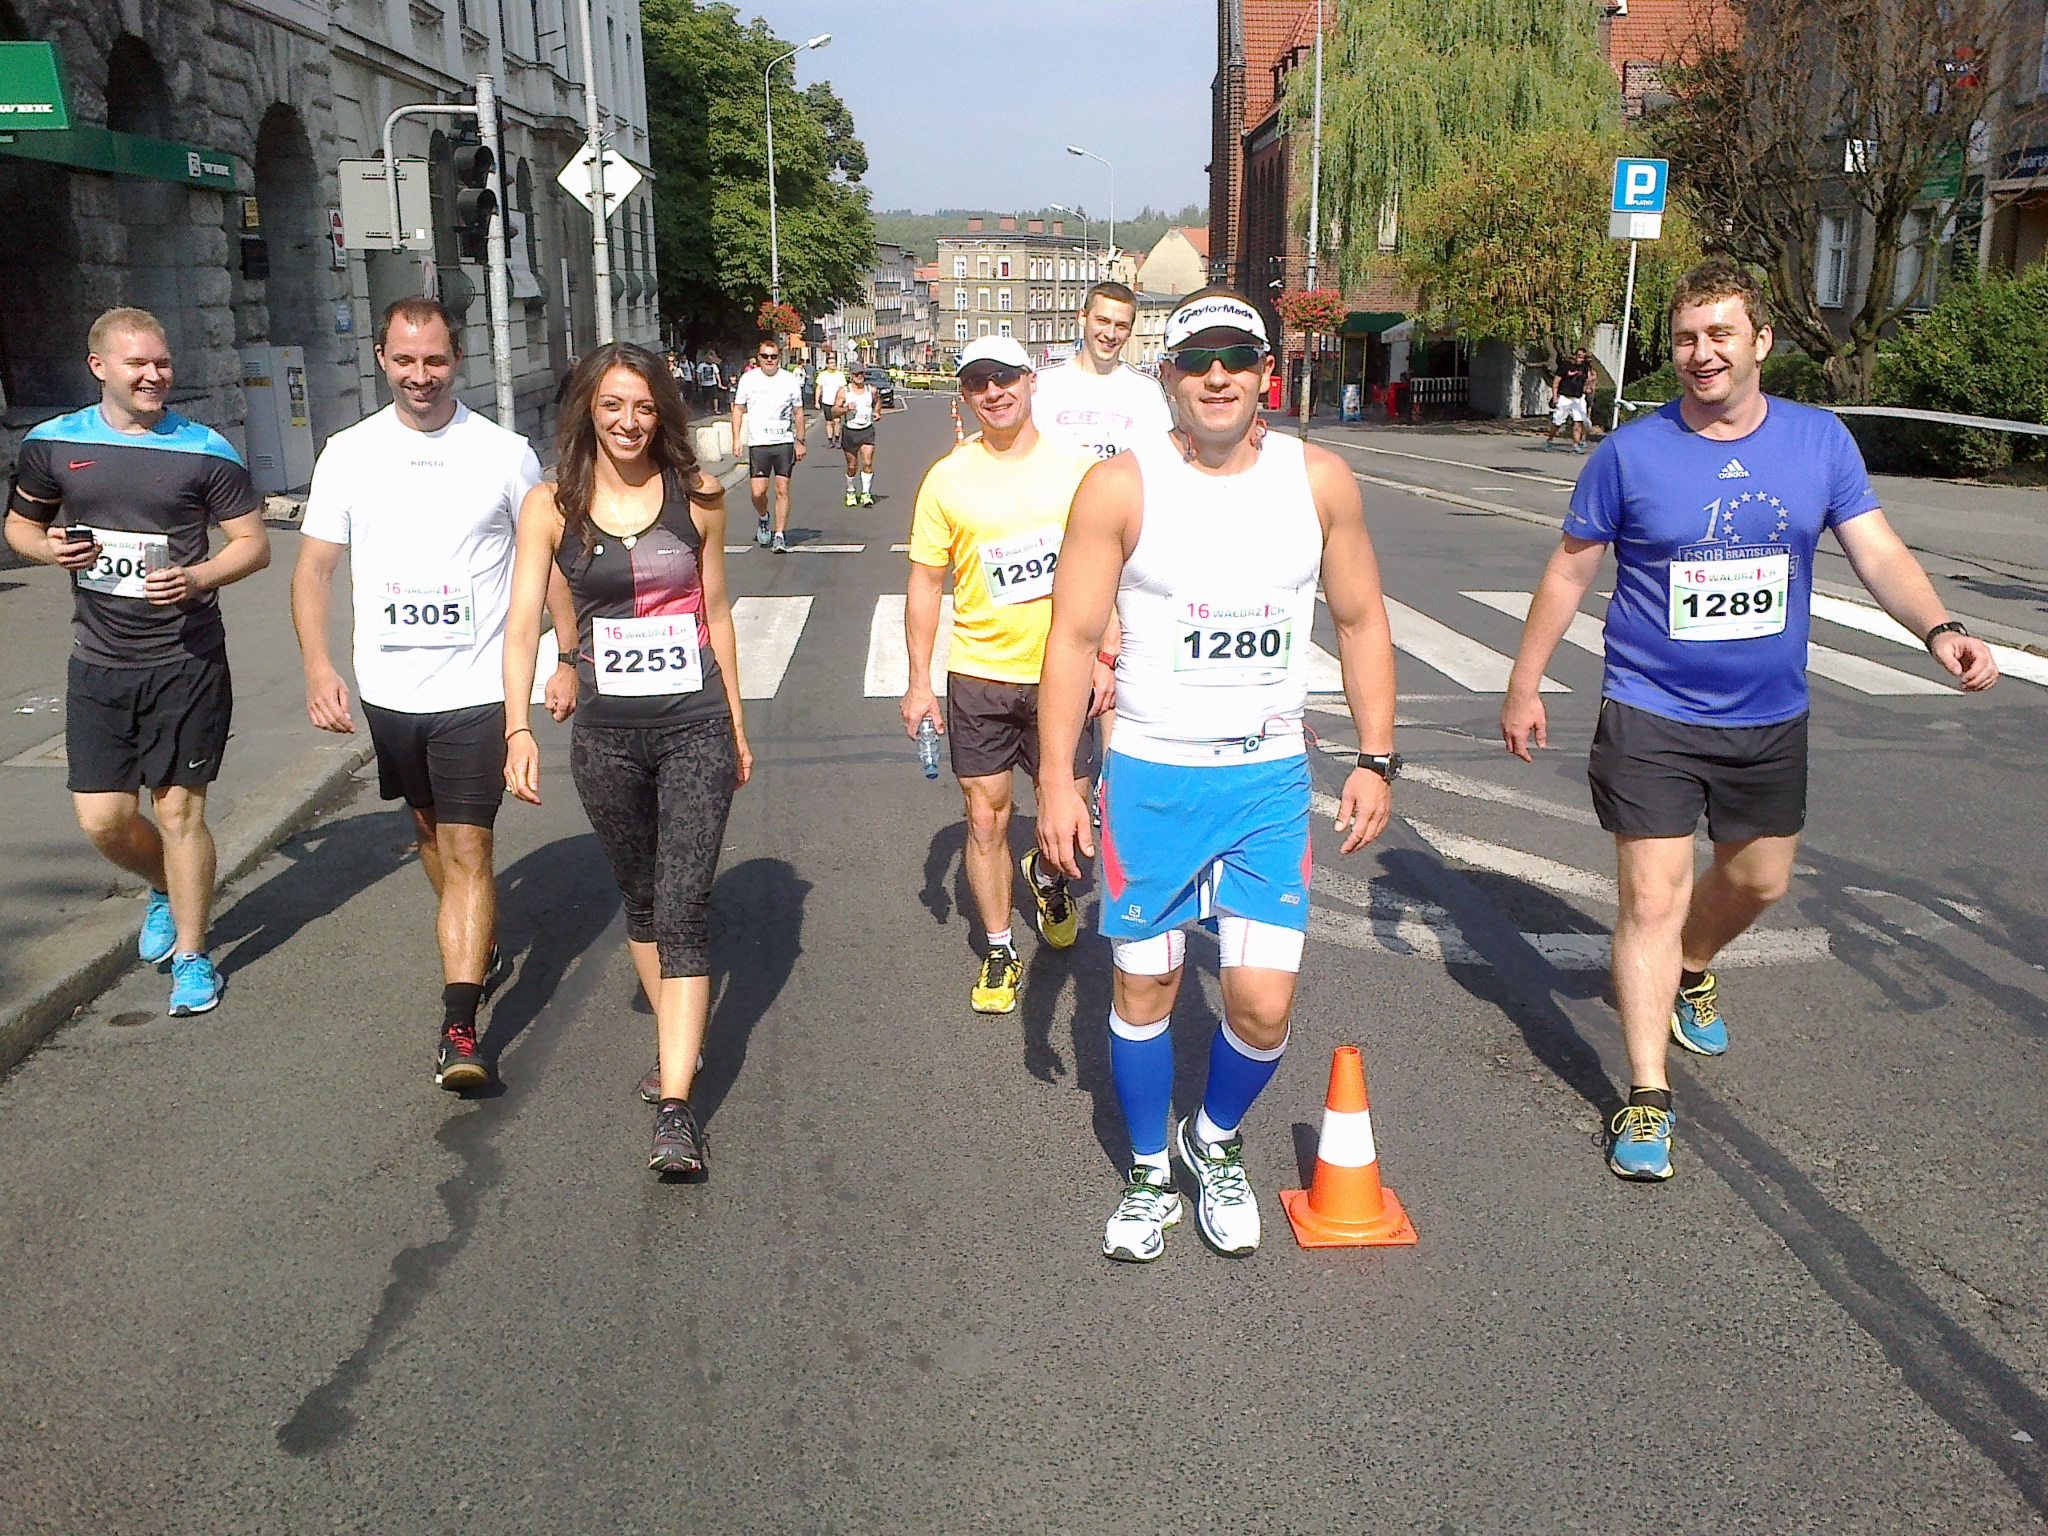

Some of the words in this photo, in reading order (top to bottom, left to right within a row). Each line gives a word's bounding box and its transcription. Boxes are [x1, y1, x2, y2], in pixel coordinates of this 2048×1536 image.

[1625, 165, 1657, 205] P
[1178, 304, 1253, 324] TaylorMade
[1719, 470, 1751, 480] adidas
[88, 556, 147, 579] 308
[992, 552, 1059, 587] 1292
[1684, 569, 1706, 583] 16
[384, 603, 460, 625] 1305
[1187, 603, 1210, 619] 16
[1682, 589, 1773, 618] 1289
[605, 627, 623, 640] 16
[1184, 629, 1281, 659] 1280
[604, 646, 688, 673] 2253
